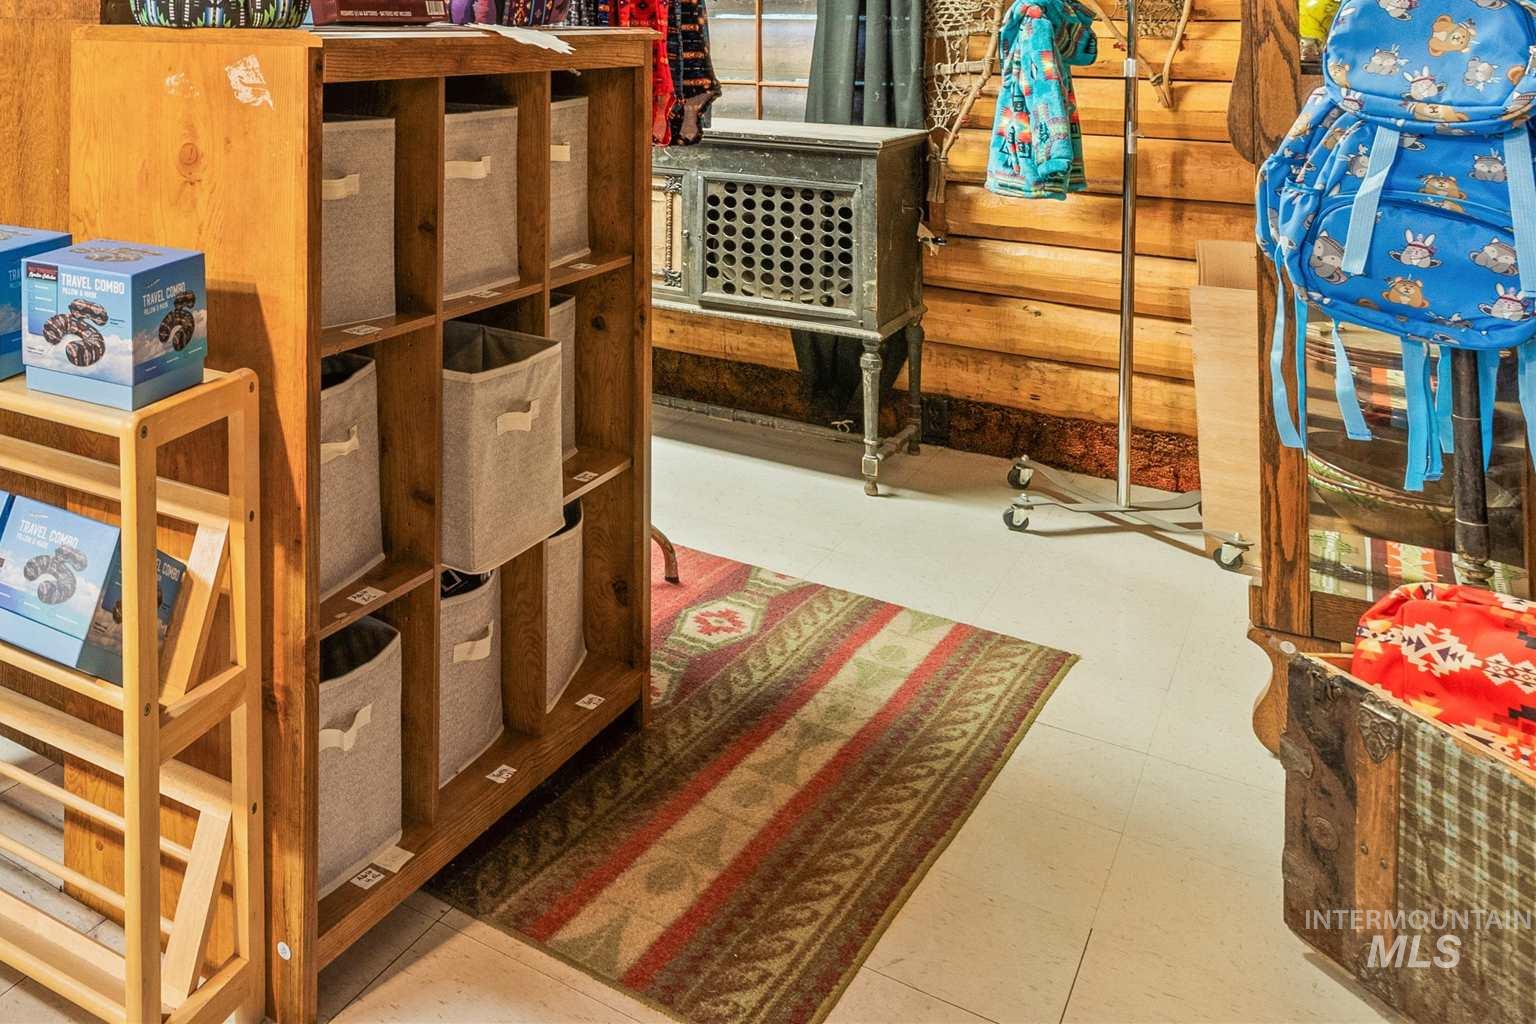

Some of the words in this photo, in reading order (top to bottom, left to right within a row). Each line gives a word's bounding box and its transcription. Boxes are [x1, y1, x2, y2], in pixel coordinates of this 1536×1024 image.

[61, 273, 92, 289] TRAVEL
[94, 278, 125, 295] COMBO
[142, 289, 165, 308] TRAVEL
[19, 519, 48, 539] TRAVEL
[48, 530, 80, 548] COMBO
